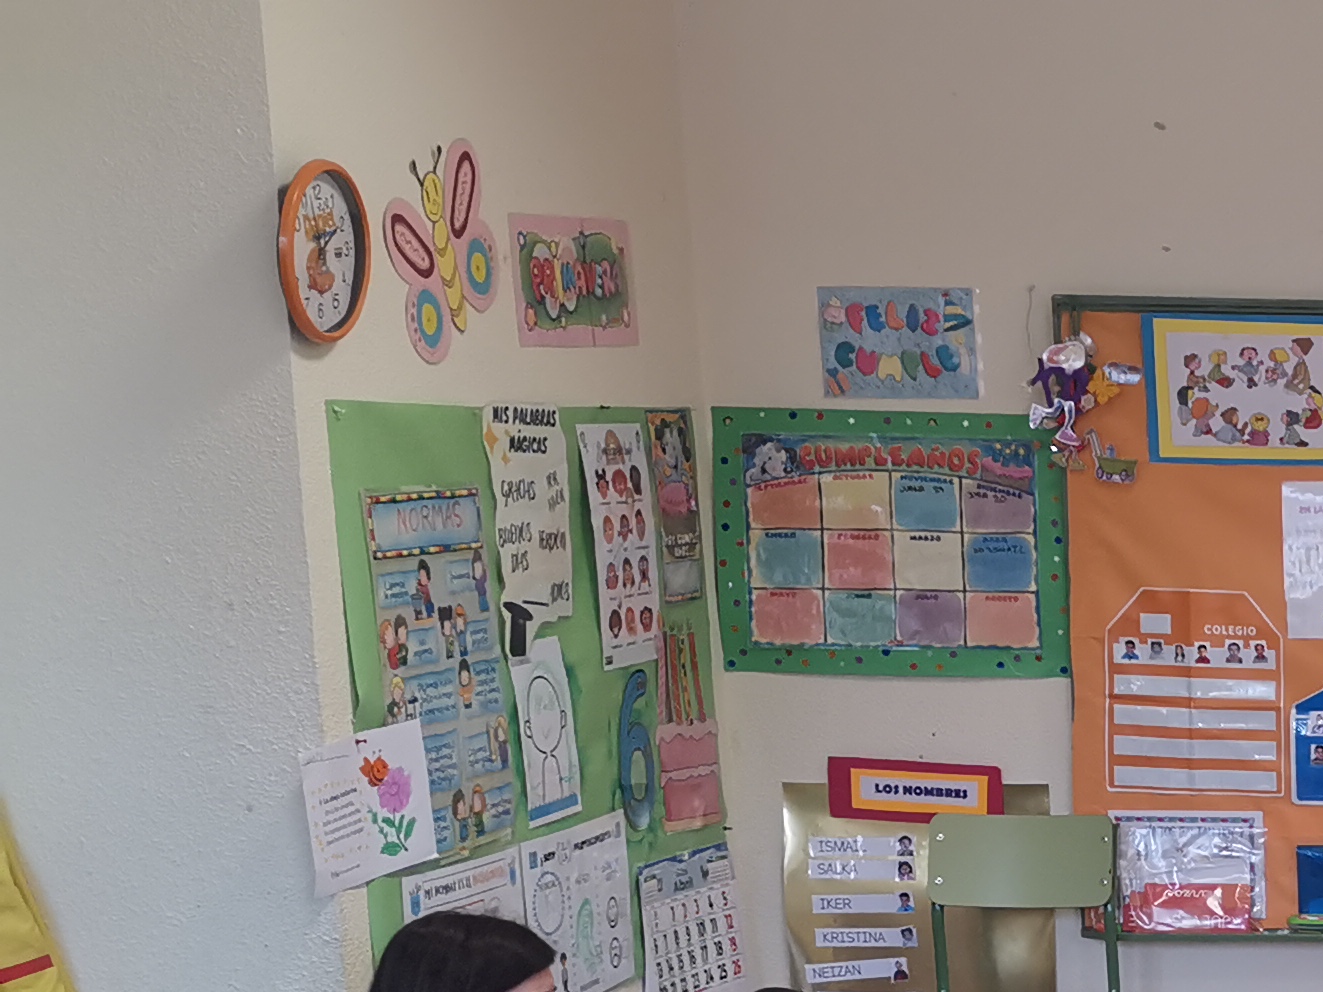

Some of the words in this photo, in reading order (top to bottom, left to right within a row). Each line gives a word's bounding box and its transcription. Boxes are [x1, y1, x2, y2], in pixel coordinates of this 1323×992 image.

[317, 302, 324, 319] 6
[492, 406, 509, 424] MIS
[512, 407, 557, 427] PALABRAS
[800, 443, 981, 476] CUMPLEAÑOS
[397, 501, 464, 534] NORMAS
[1203, 624, 1257, 637] COLEGIO
[874, 783, 899, 795] LOS
[903, 785, 968, 800] NOMBRES
[817, 863, 858, 875] SALKA
[819, 898, 852, 910] IKER
[821, 931, 887, 944] KRISTINA
[812, 964, 862, 979] NEIZAN
